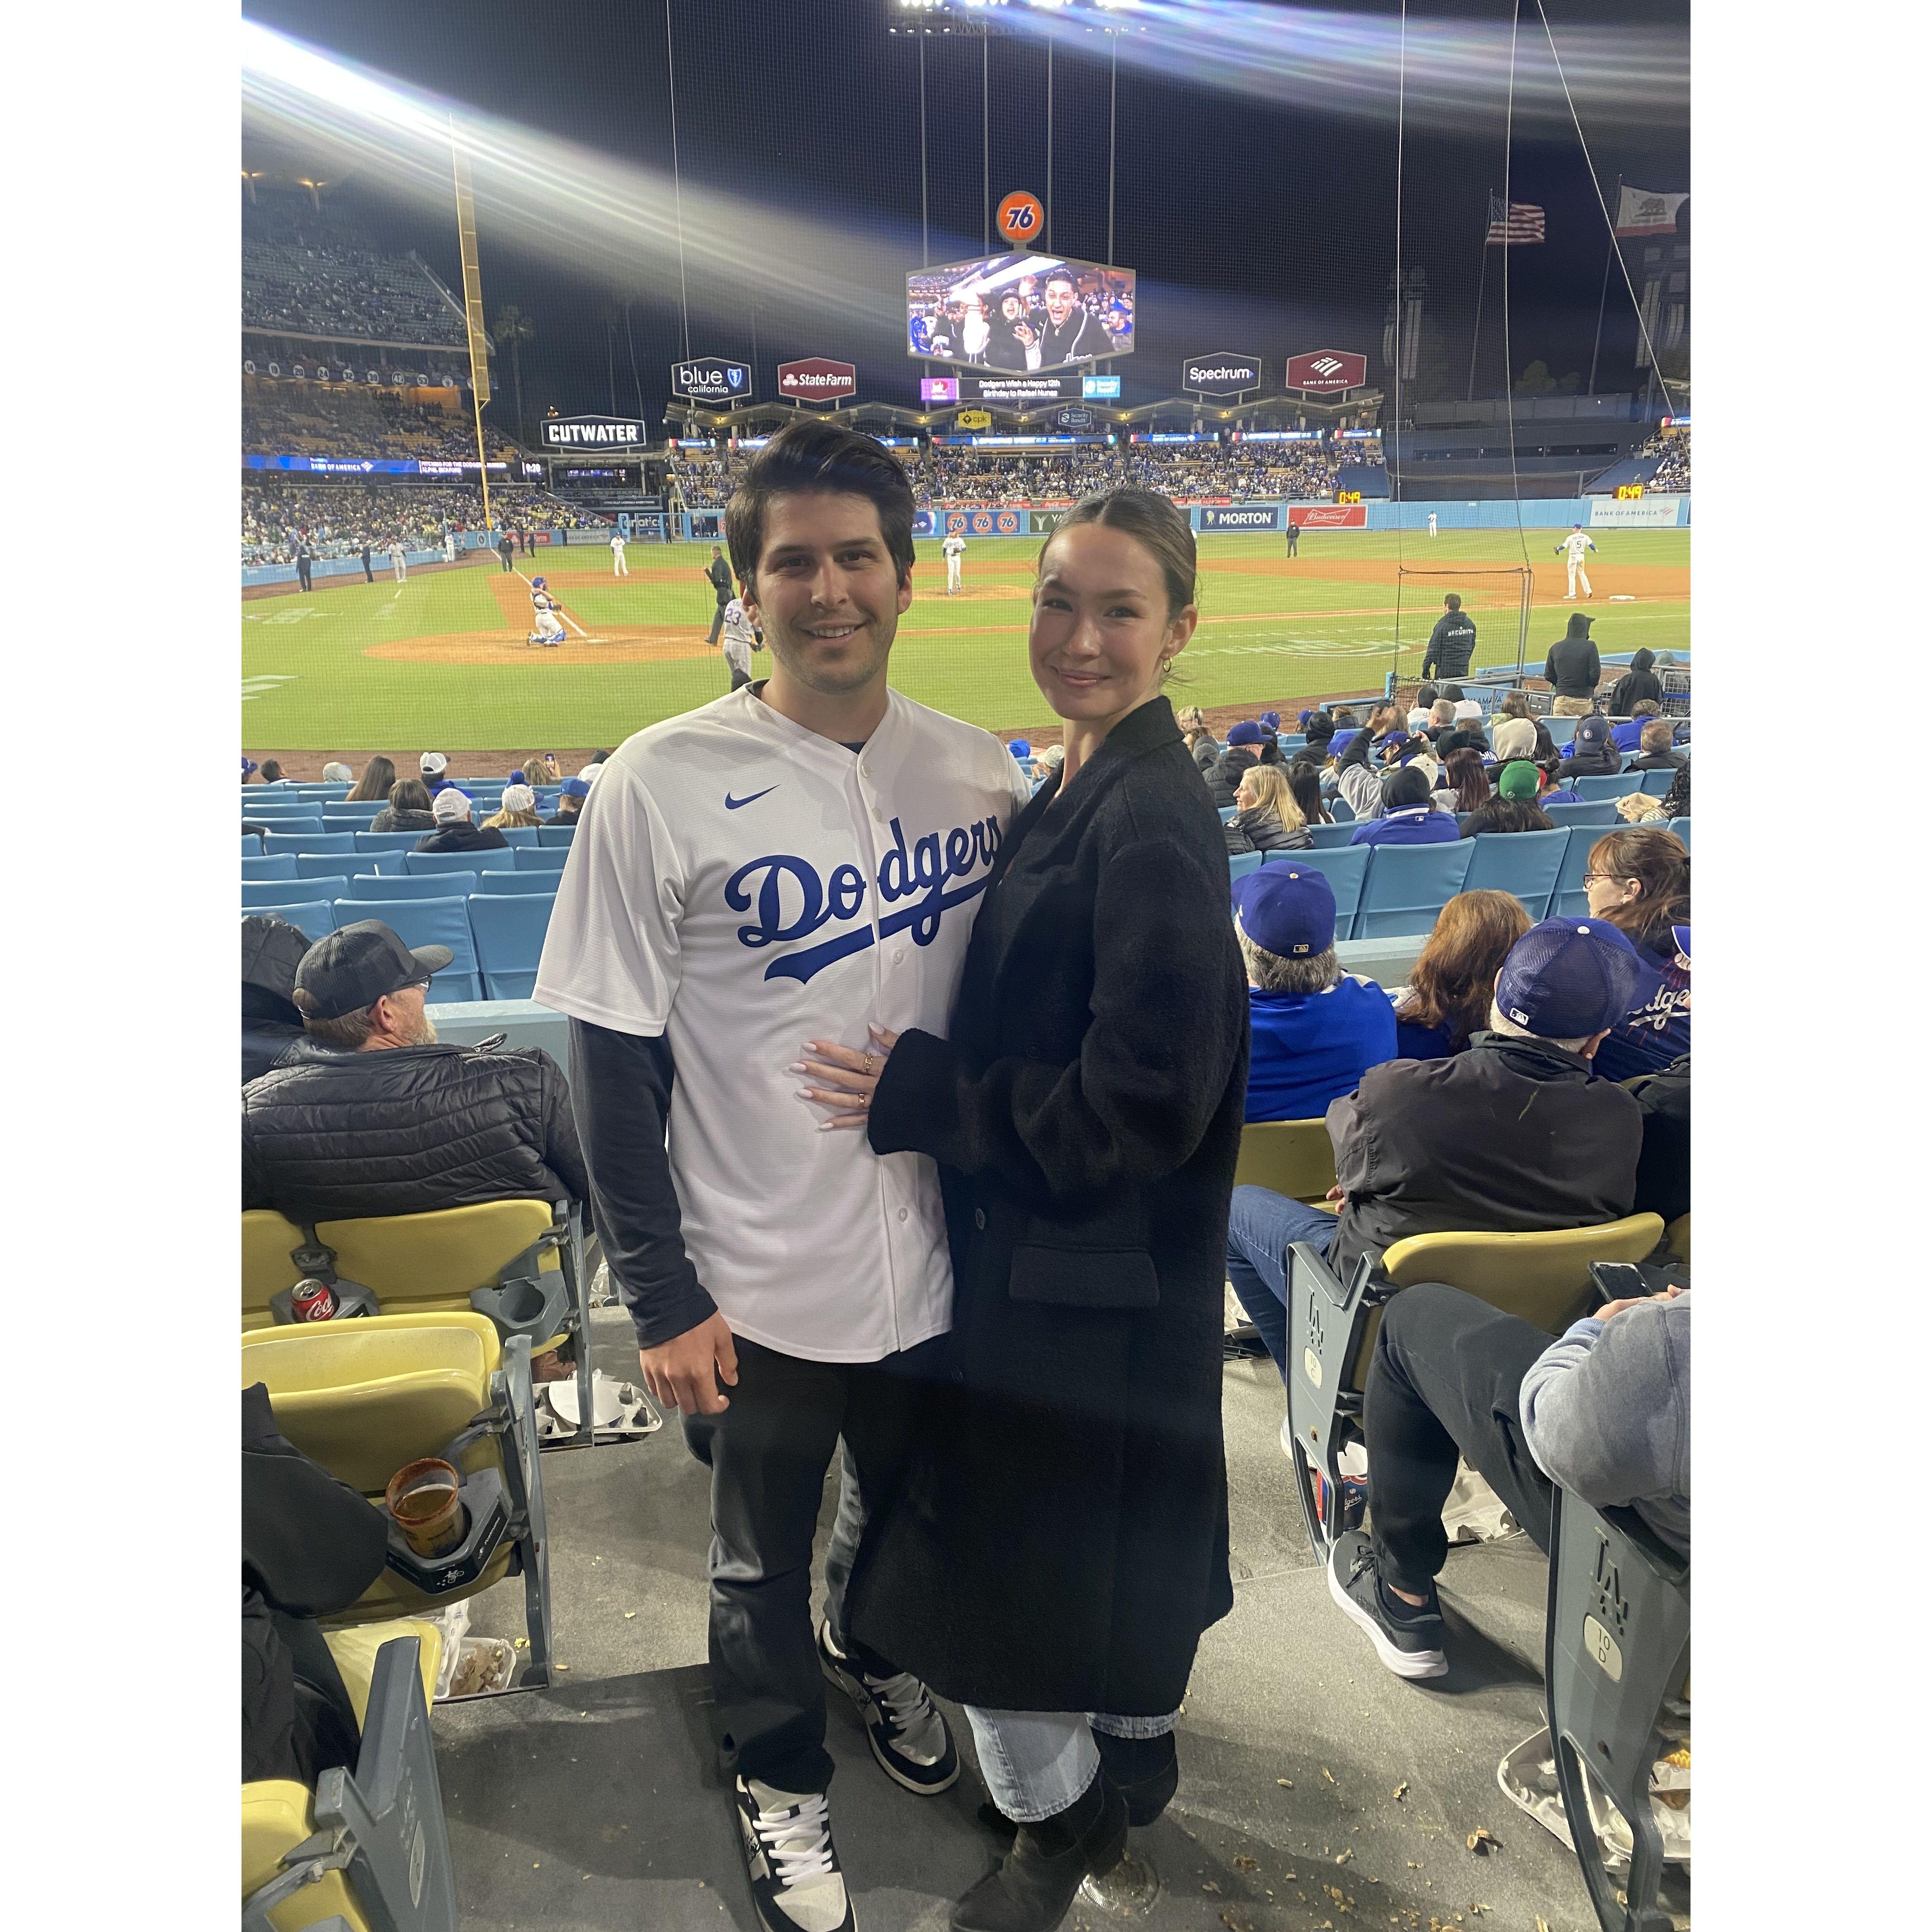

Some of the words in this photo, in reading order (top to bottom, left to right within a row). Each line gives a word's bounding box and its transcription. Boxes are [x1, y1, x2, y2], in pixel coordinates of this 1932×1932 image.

[1007, 206, 1035, 230] 76
[295, 368, 303, 376] 20
[680, 366, 723, 384] blue
[1189, 367, 1250, 382] Spectrum
[393, 375, 403, 383] 42
[979, 380, 1005, 389] Dodgers
[1027, 380, 1047, 388] Happy
[687, 385, 728, 393] california
[983, 390, 1009, 398] Birthday
[973, 415, 987, 424] cpk
[548, 425, 638, 442] CUTWATER
[1338, 492, 1361, 505] 0:49
[1618, 485, 1643, 500] 0:49
[1219, 512, 1272, 524] MORTON
[1308, 510, 1346, 521] Budweiser
[951, 518, 964, 528] 76
[977, 517, 989, 528] 76
[1001, 517, 1014, 527] 76
[1576, 540, 1582, 549] 5
[725, 608, 742, 626] 23
[724, 814, 1003, 948] Dodgers
[1310, 1354, 1317, 1368] 10
[1598, 1628, 1610, 1651] 10
[1598, 1648, 1607, 1663] D
